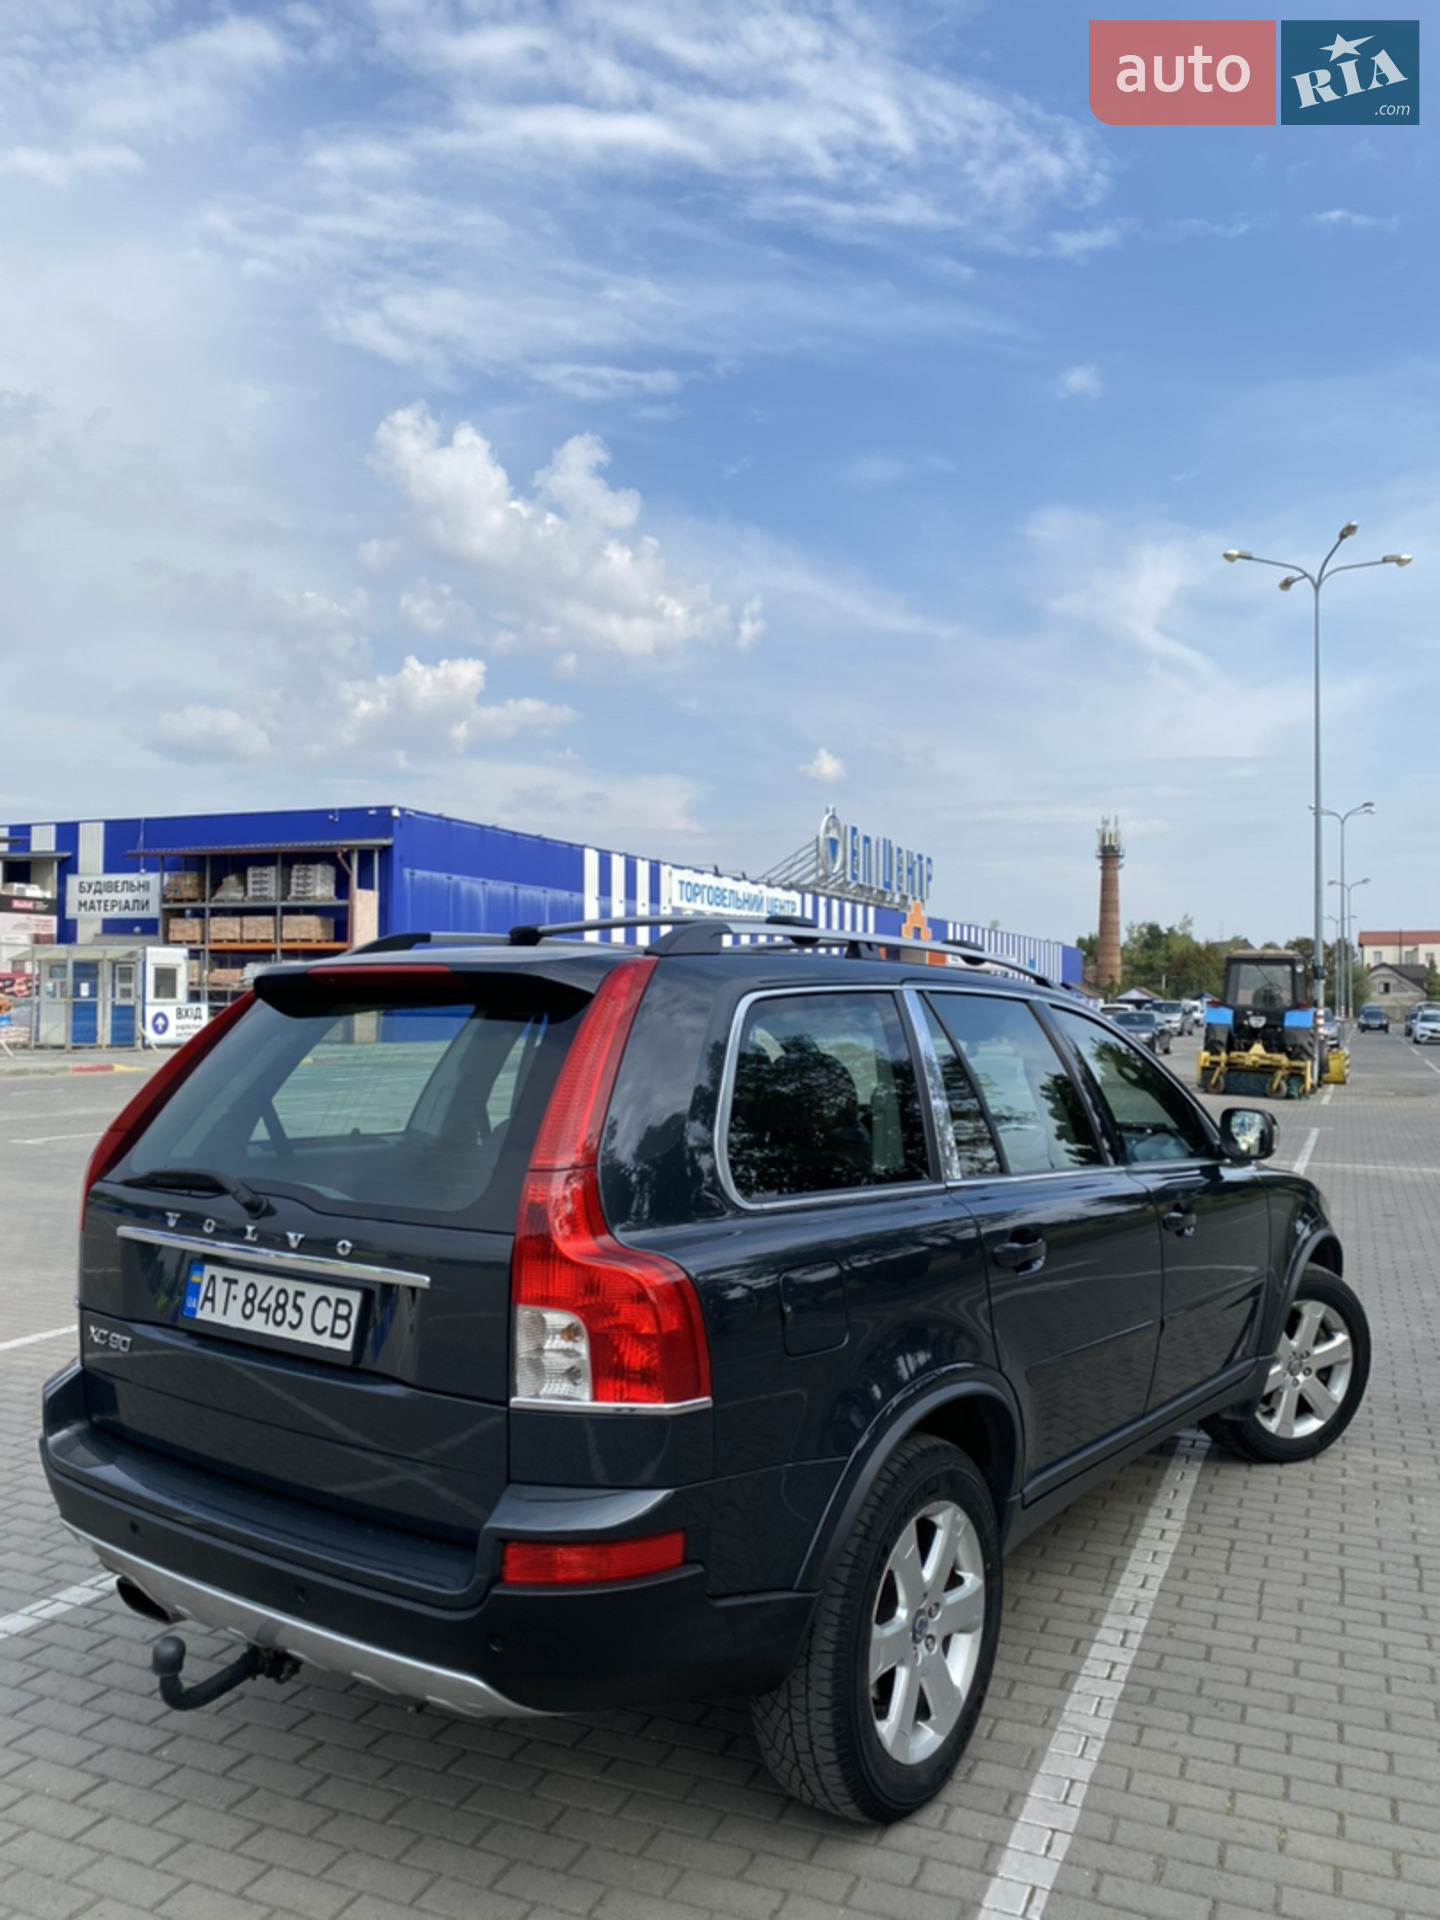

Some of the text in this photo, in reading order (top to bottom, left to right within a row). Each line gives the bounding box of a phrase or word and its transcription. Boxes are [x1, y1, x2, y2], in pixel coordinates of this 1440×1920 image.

[78, 880, 150, 895] БУДІВЕЛЬНІ
[677, 879, 797, 917] ТОРГОВЕЛЬНИЙ ЦЕНТР
[77, 899, 150, 913] МАТЕРІАЛИ
[175, 1007, 203, 1021] ВХІД
[165, 1211, 353, 1256] VOLVO
[241, 1281, 306, 1330] 8485
